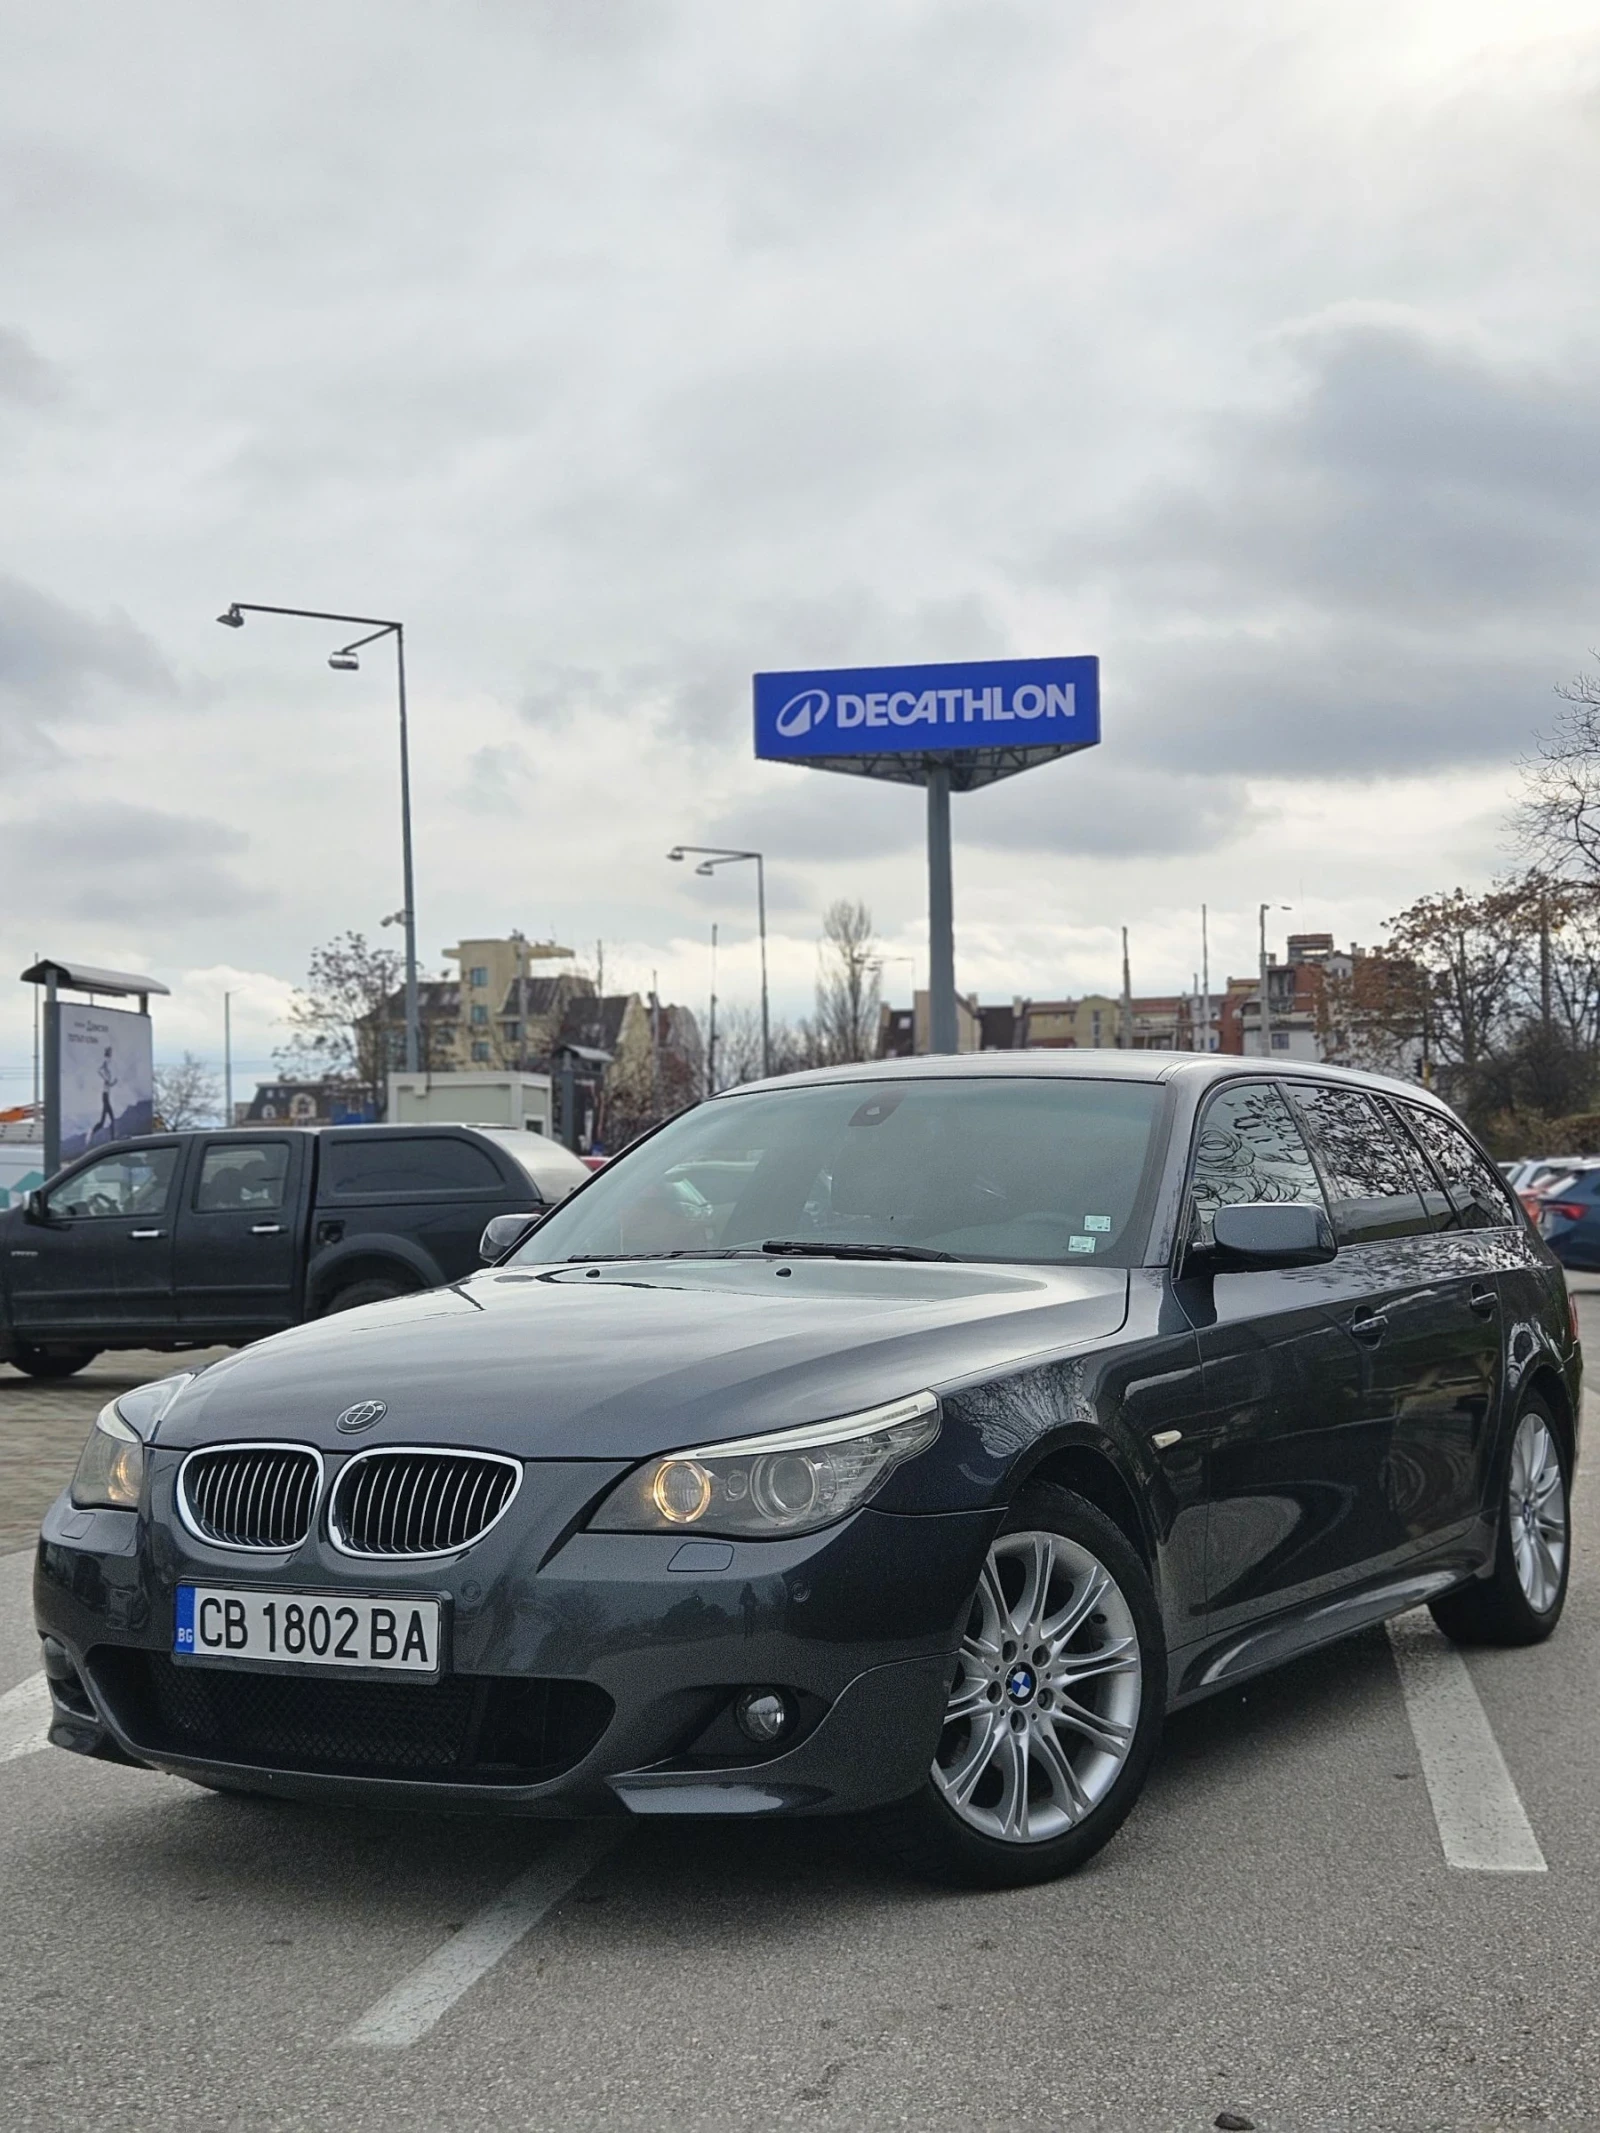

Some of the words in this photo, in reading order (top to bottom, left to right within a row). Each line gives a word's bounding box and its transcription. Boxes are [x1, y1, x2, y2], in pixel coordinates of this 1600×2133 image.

[837, 683, 1076, 728] DECATHLON
[177, 1627, 193, 1644] BG
[199, 1597, 248, 1650] CB
[262, 1602, 359, 1658] 1802
[370, 1608, 428, 1662] BA
